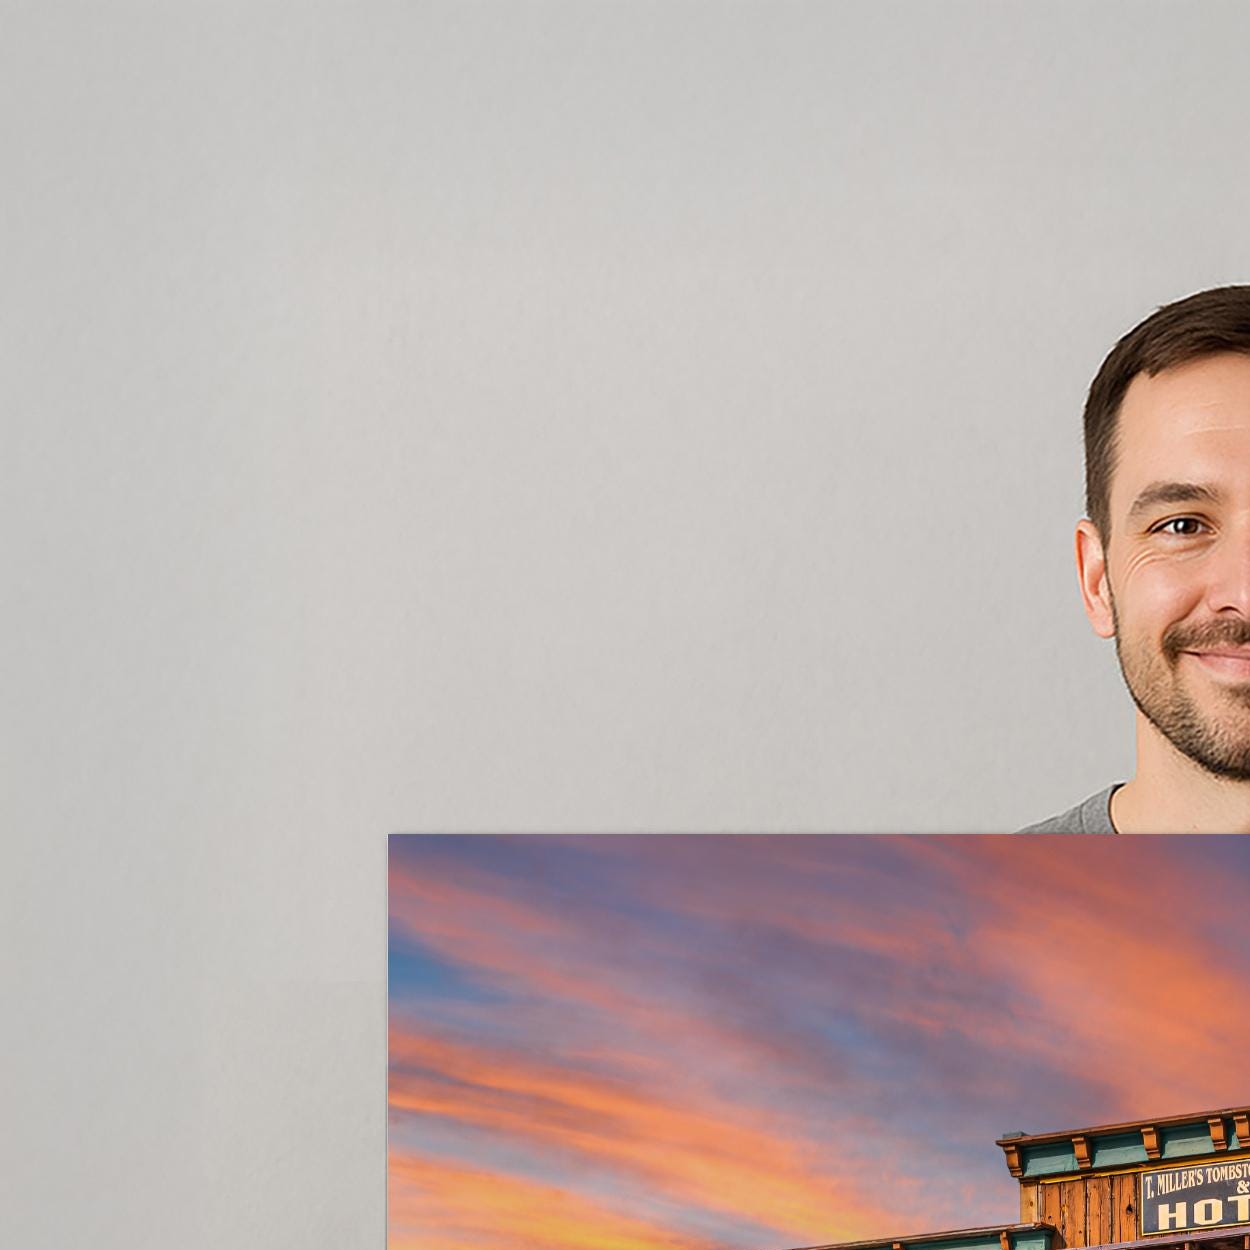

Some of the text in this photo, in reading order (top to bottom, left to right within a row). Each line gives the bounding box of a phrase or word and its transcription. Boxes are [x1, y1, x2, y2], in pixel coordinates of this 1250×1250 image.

[1146, 1176, 1154, 1200] T.
[1157, 1168, 1204, 1196] MILLER'S
[1236, 1180, 1250, 1194] &
